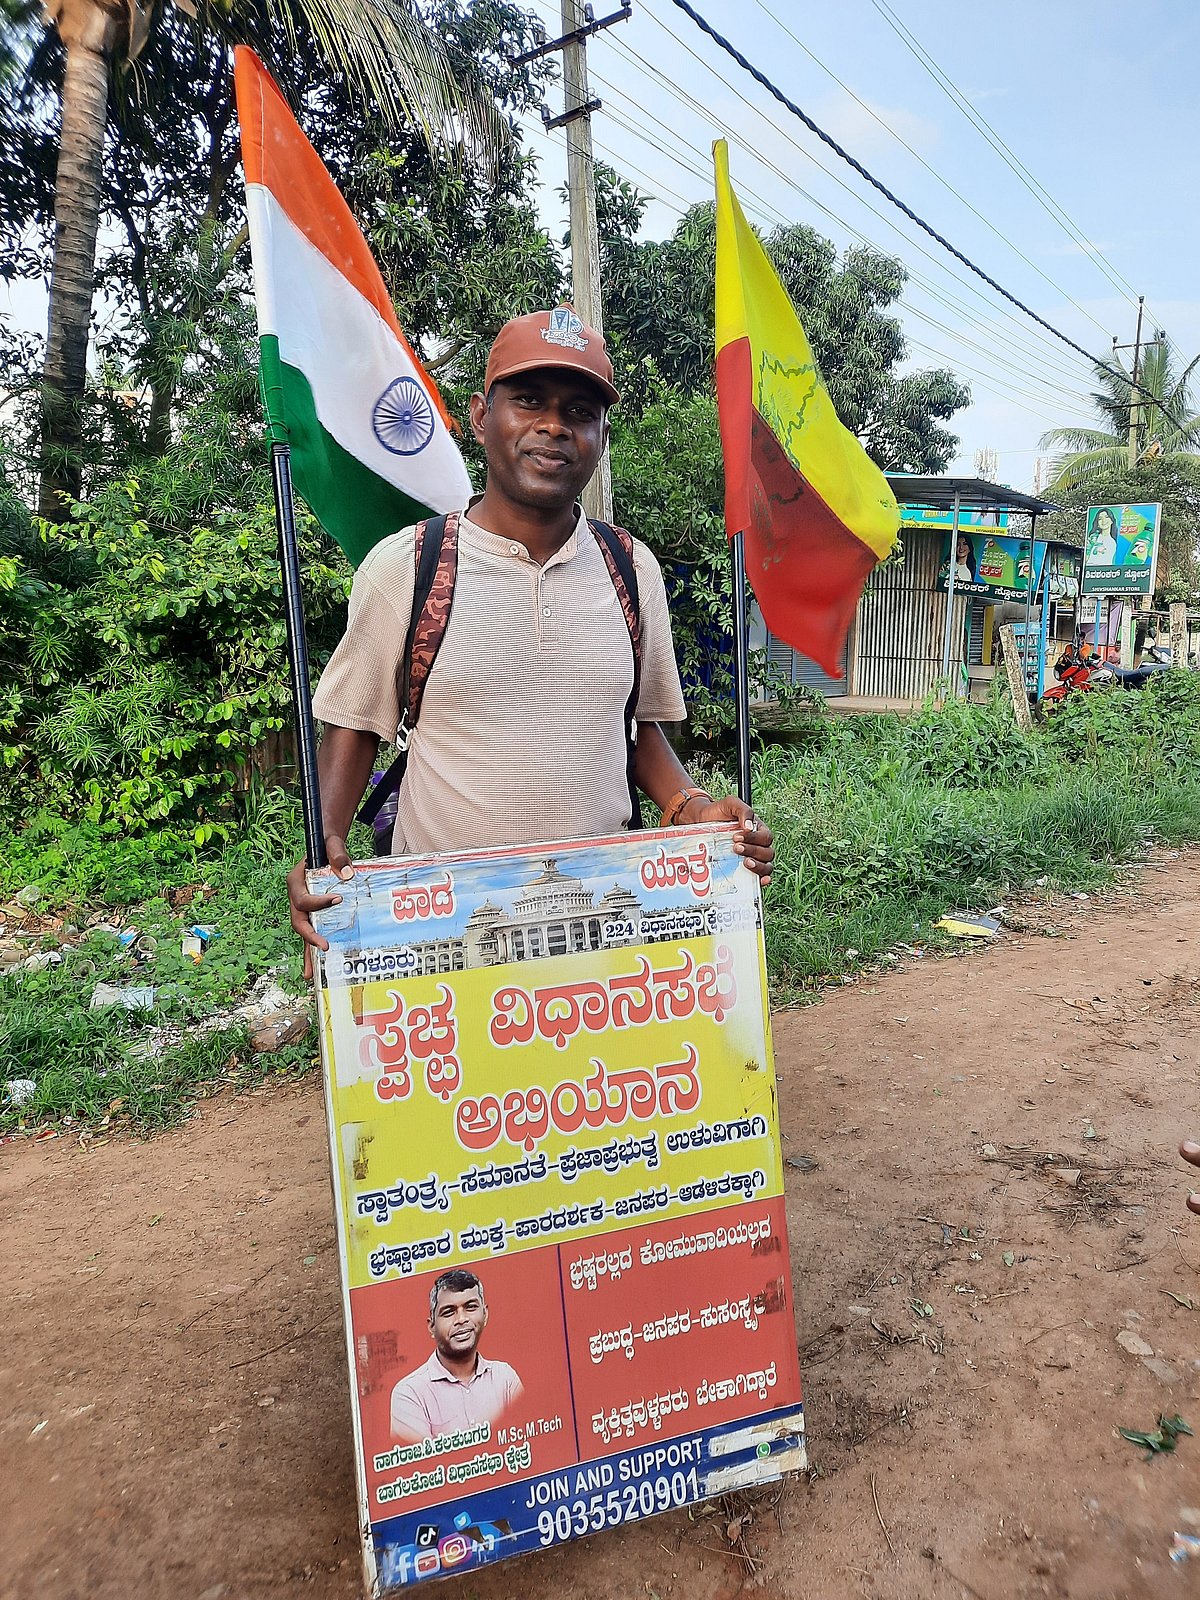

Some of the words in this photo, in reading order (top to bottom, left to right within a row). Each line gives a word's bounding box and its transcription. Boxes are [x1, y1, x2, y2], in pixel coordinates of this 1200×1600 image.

[391, 872, 454, 921] ಪಾದ
[640, 842, 710, 897] ಯಾತ್ರೆ
[605, 921, 635, 938] 224
[640, 914, 701, 934] ವಿಧಾನಸಭಾ
[354, 984, 461, 1101] ಸ್ವಚ್ಛ
[490, 945, 738, 1048] ವಿಧಾನಸಭೆ
[456, 1044, 702, 1151] ಅಭಿಯಾನ
[667, 1116, 765, 1151] ಉಳುವಿಗಾಗಿ
[370, 1232, 451, 1276] ಭ್ರಷ್ಟಾಚಾರ
[570, 1245, 632, 1290] ಭ್ರಷ್ಟರಲ್ಲದ
[640, 1213, 771, 1264] ಕೋಮುವಾದಿಯಲ್ಲದ
[696, 1361, 777, 1405] ಬೇಕಾಗಿದ್ದಾರೆ
[497, 1415, 562, 1446] M.Sc,M.Tech
[378, 1466, 444, 1502] ಬಾಗಲಕೋಟೆ
[448, 1455, 501, 1483] ವಿಧಾನಸಭಾ
[506, 1443, 531, 1472] ಕ್ಷೇತ್ರ
[526, 1475, 570, 1508] JOIN
[575, 1464, 614, 1494] AND
[618, 1438, 702, 1481] SUPPORT
[537, 1466, 699, 1546] 9035520901
